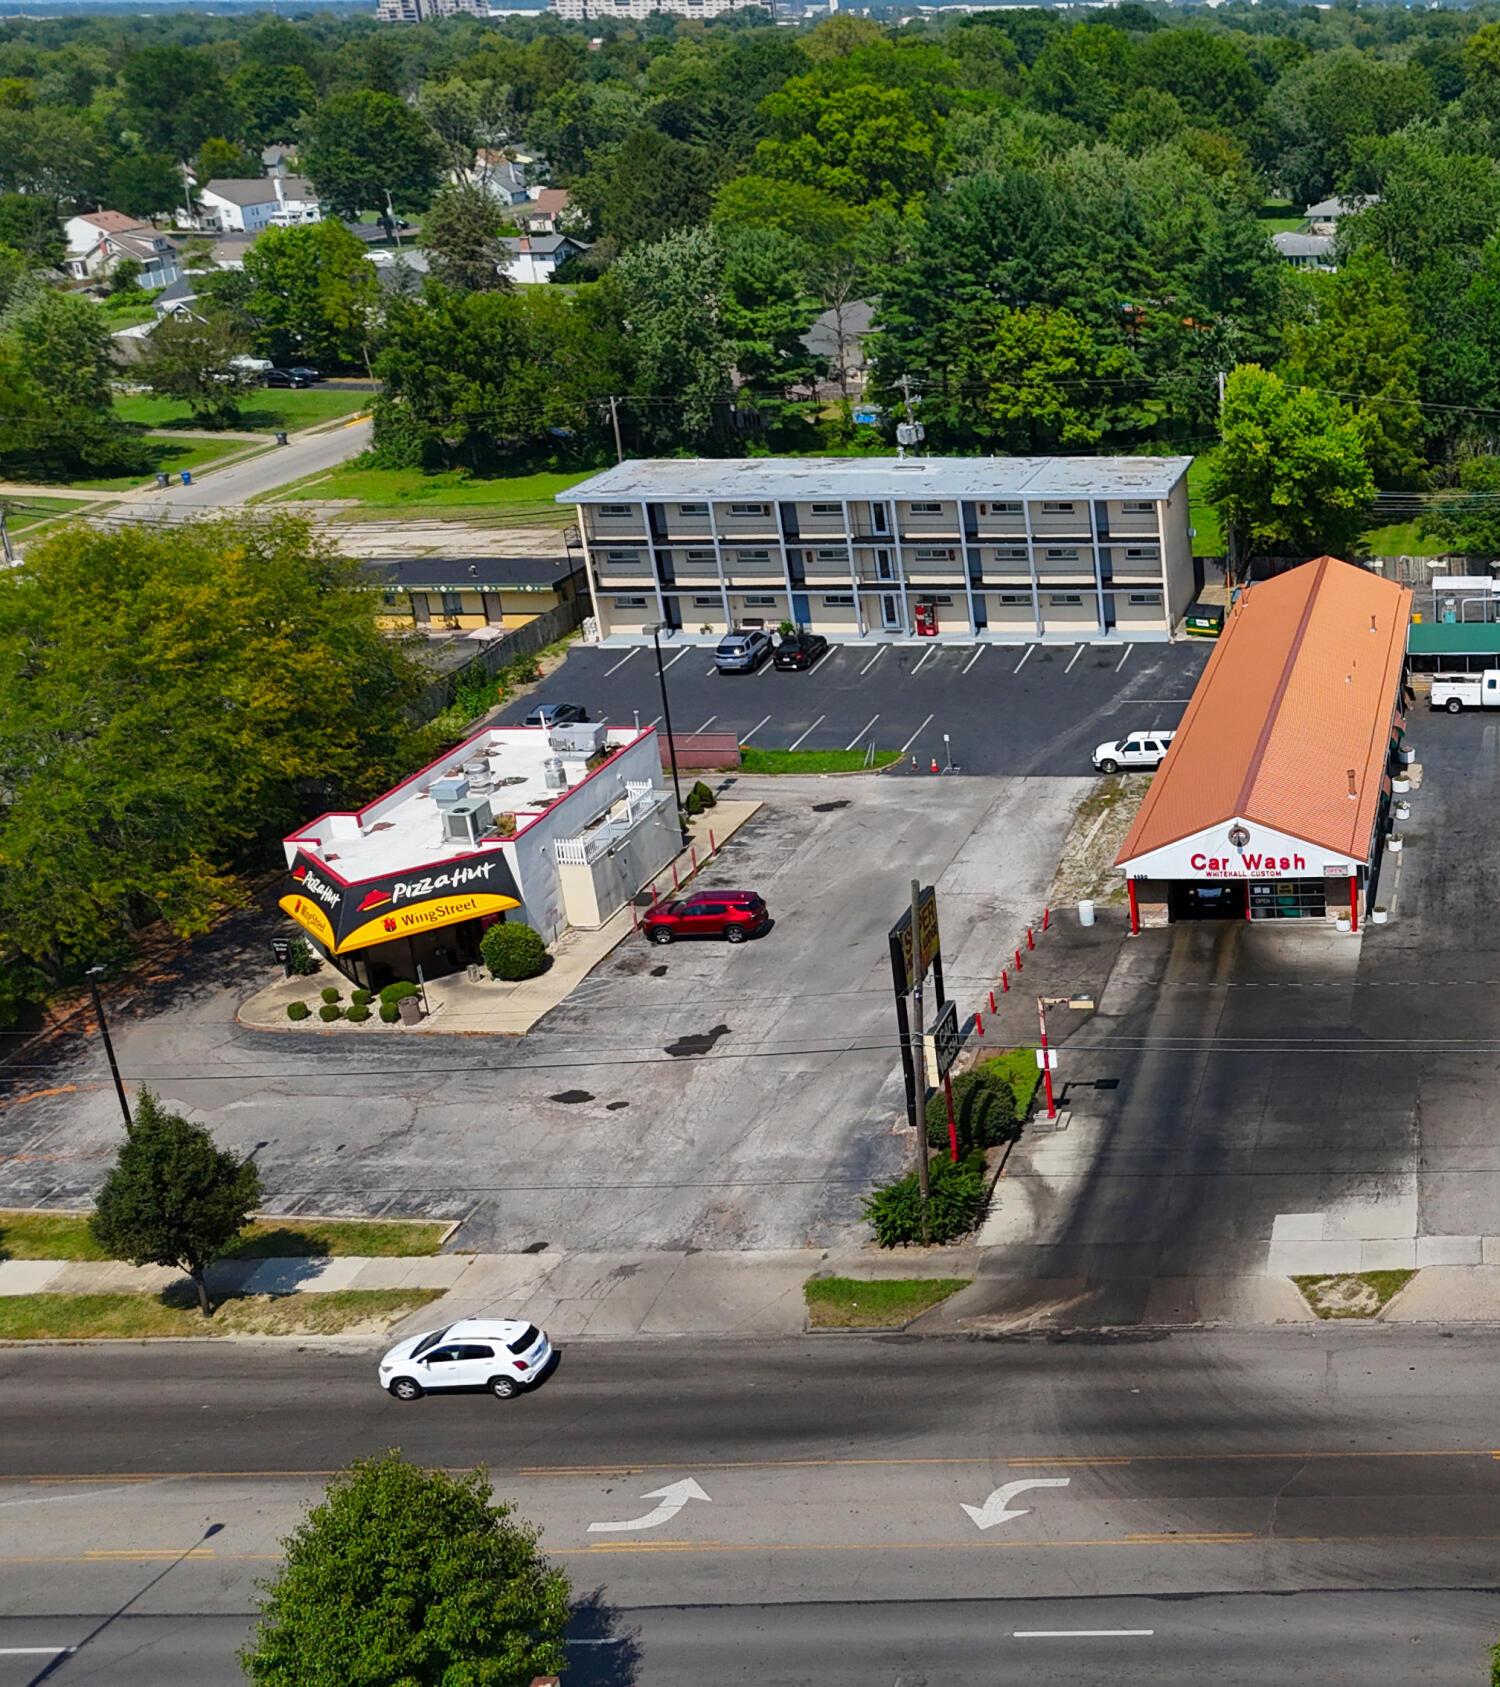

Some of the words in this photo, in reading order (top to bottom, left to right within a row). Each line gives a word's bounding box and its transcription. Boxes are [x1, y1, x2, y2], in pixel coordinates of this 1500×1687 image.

[1190, 853, 1229, 870] Car
[1242, 853, 1306, 870] Wash
[392, 874, 451, 904] Pizza
[449, 862, 497, 888] Hut
[320, 885, 341, 909] Hut
[401, 897, 478, 927] WingStreet
